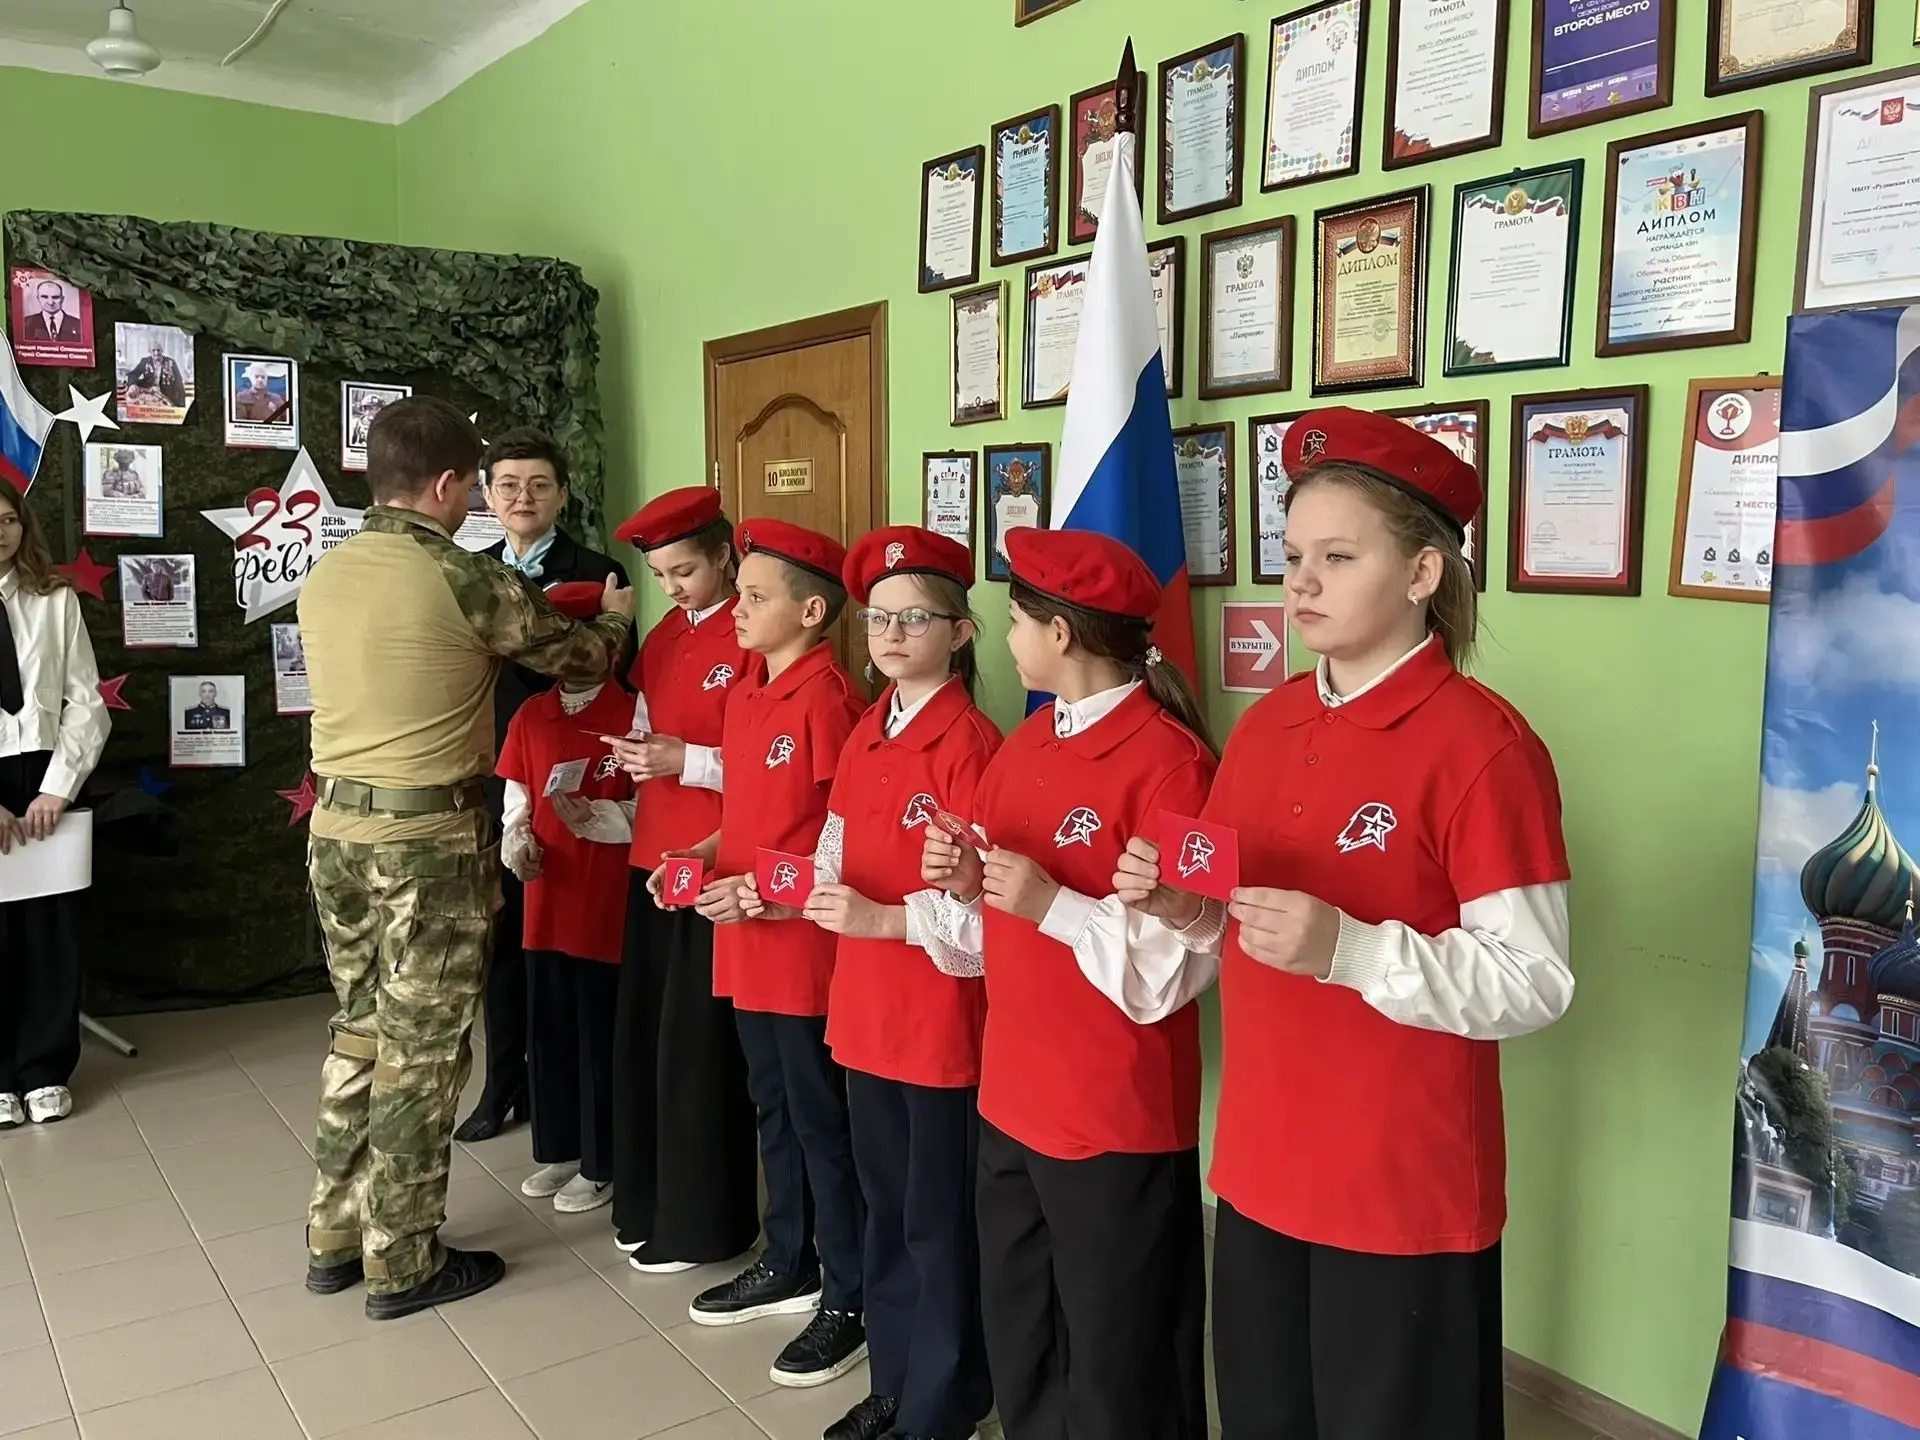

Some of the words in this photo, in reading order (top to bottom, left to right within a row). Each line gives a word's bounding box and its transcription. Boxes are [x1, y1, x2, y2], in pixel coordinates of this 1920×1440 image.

[1428, 0, 1466, 18] ГРАМОТА
[1554, 14, 1604, 37] ВТОРОЕ
[1605, 1, 1650, 22] МЕСТО
[1295, 59, 1335, 82] ДИПЛОМ
[1186, 83, 1214, 98] ГРАМОТА
[1656, 188, 1705, 212] КВН
[1493, 215, 1534, 230] ГРАМОТА
[1637, 208, 1716, 235] ДИПЛОМ
[1646, 227, 1705, 243] НАГРАЖДАЕТСЯ
[1650, 242, 1684, 253] КОМАНДА
[1337, 252, 1398, 278] ДИПЛОМ
[1225, 279, 1264, 294] ГРАМОТА
[1653, 274, 1692, 287] участник
[1547, 446, 1606, 459] ГРАМОТА
[1178, 461, 1205, 470] ГРАМОТА
[767, 471, 778, 487] 10
[786, 477, 806, 487] ХИМИЯ
[1742, 501, 1776, 509] МЕСТО
[235, 487, 321, 552] 23
[321, 516, 346, 527] ДЕНЬ
[936, 514, 961, 522] ДИПЛОМ
[1230, 641, 1236, 649] В
[1237, 641, 1274, 650] УКРЫТИЕ
